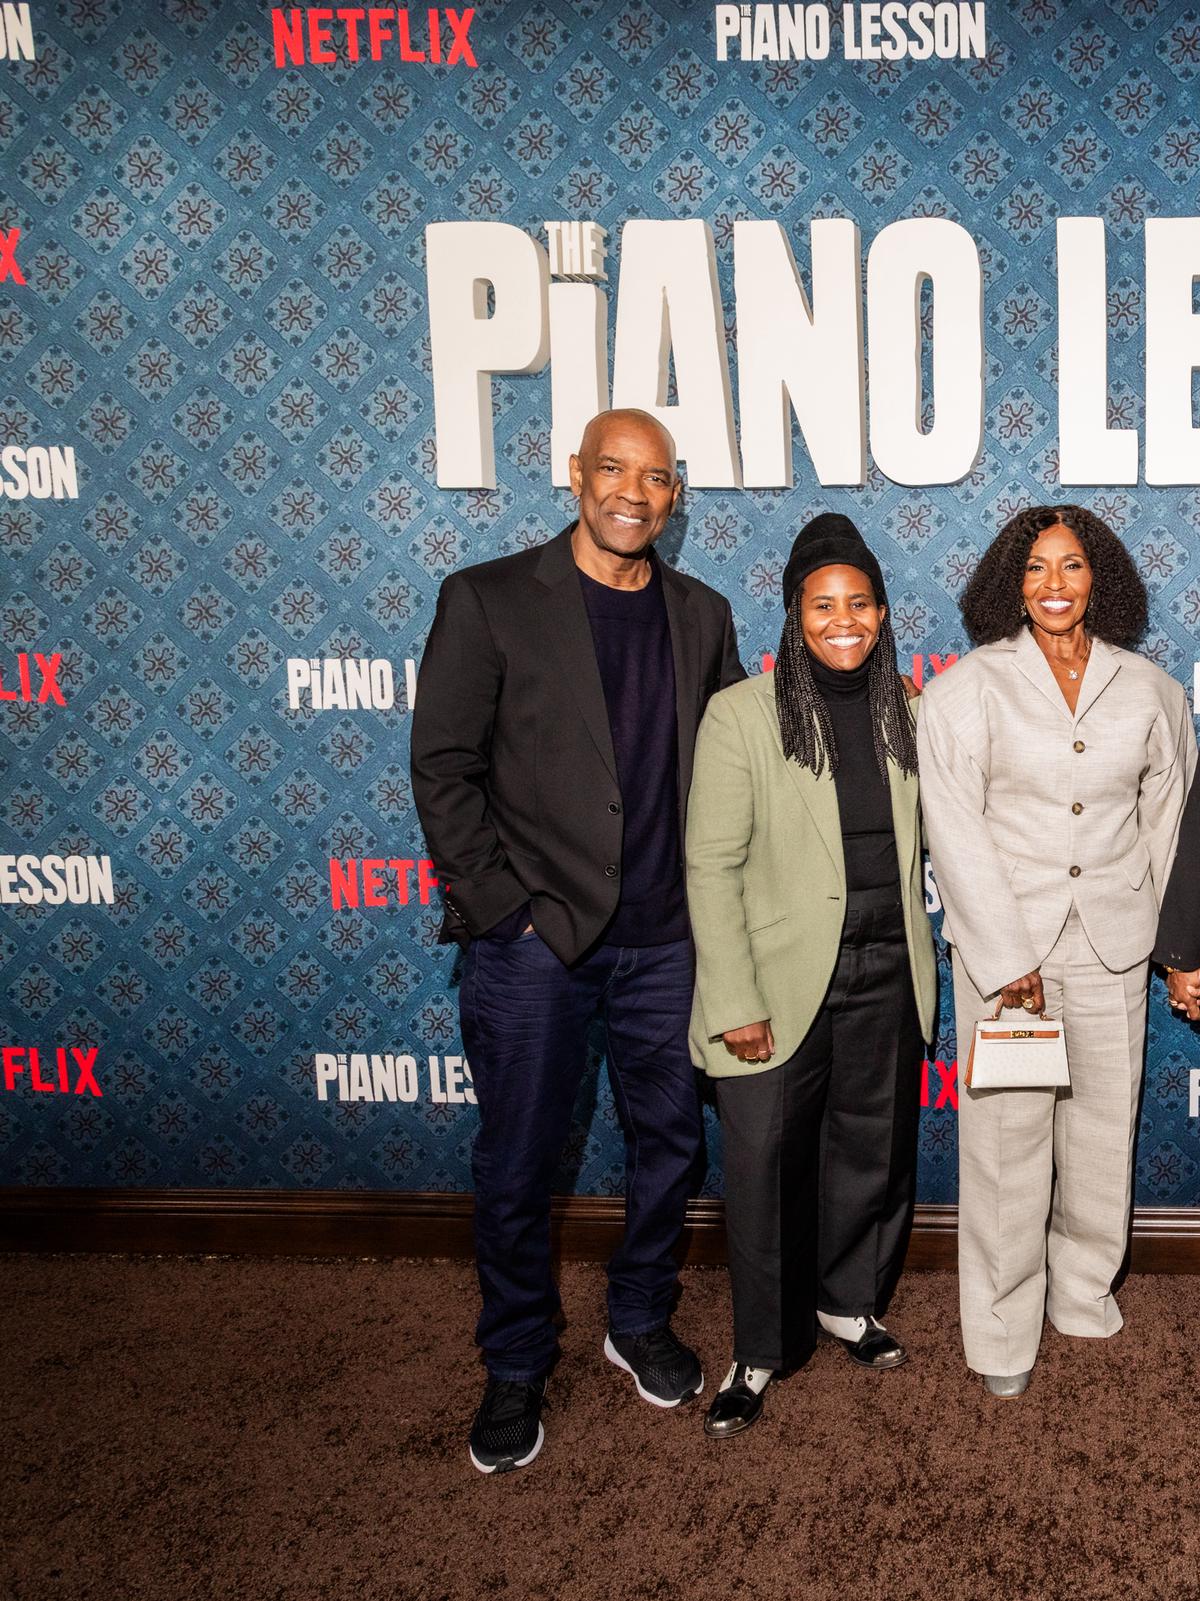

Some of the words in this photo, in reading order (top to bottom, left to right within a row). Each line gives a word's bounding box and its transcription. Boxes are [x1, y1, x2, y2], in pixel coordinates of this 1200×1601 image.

[271, 7, 479, 69] NETFLIX
[843, 1, 987, 60] LESSON
[544, 220, 608, 282] THE
[0, 445, 79, 500] SON
[329, 857, 450, 911] NETF
[2, 1046, 104, 1097] FLIX
